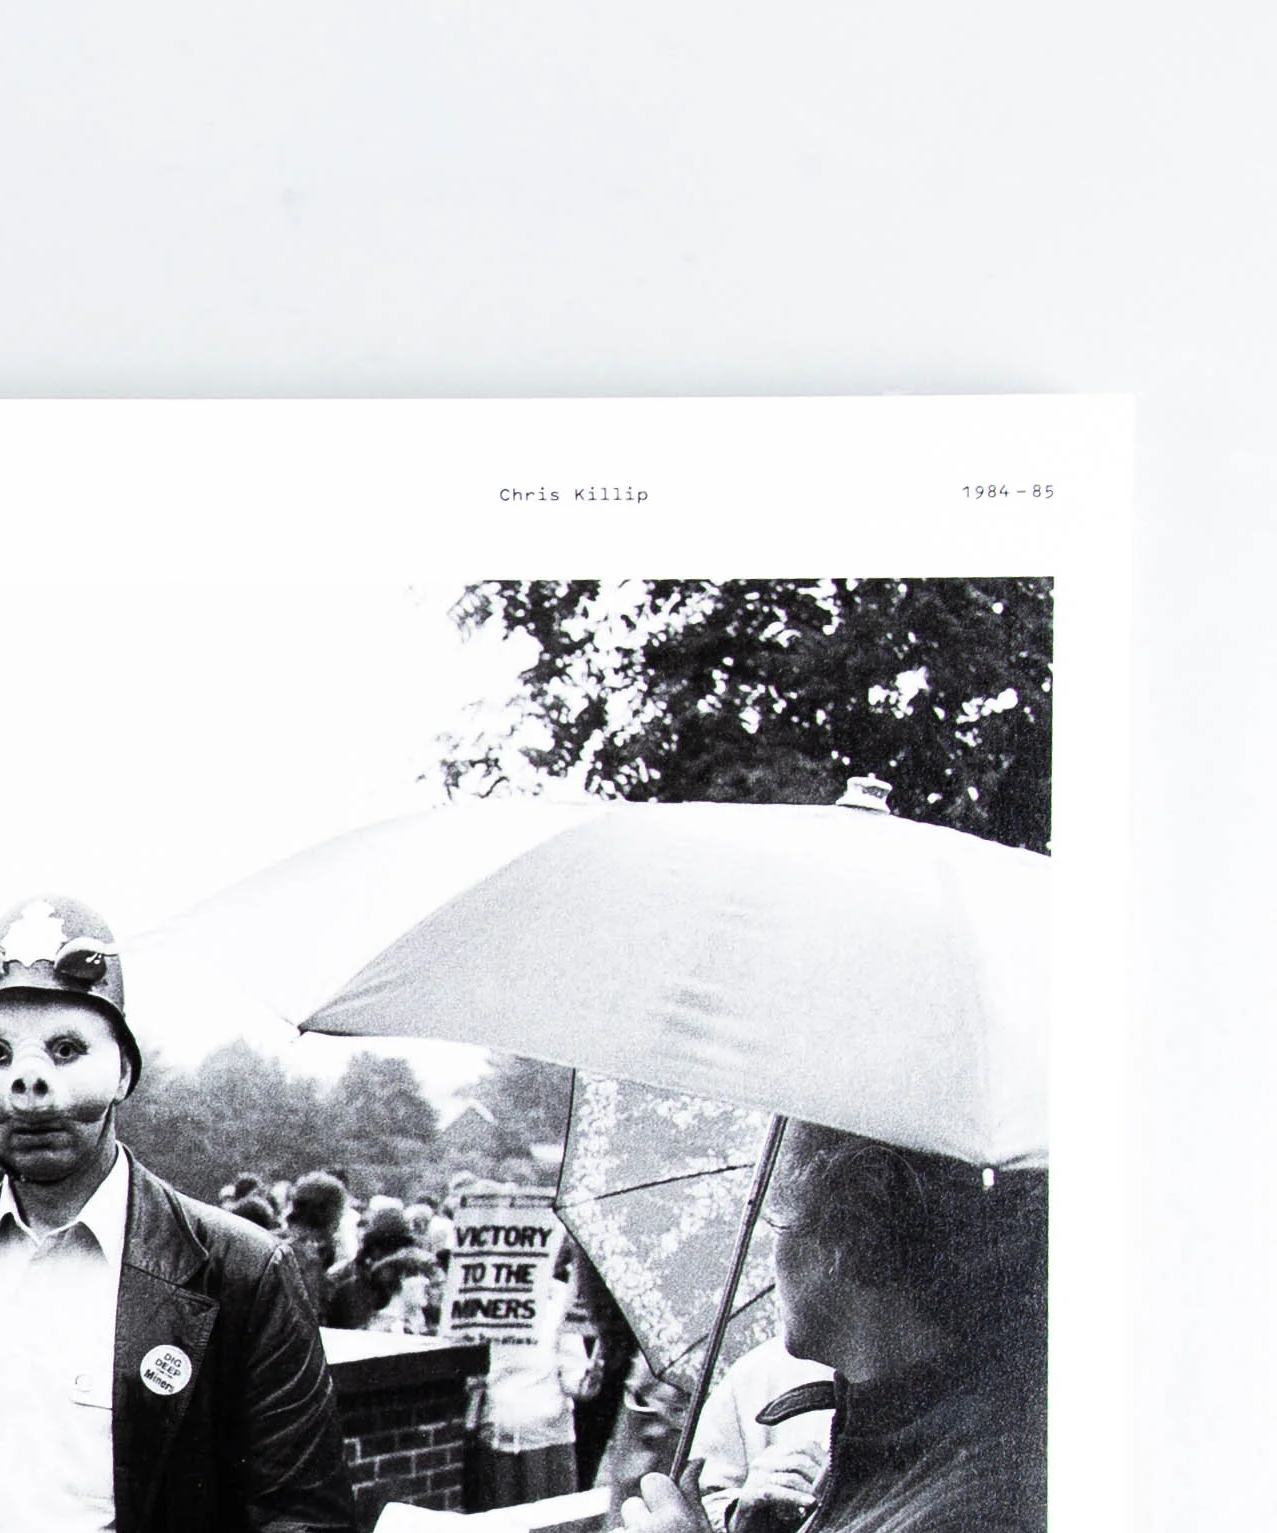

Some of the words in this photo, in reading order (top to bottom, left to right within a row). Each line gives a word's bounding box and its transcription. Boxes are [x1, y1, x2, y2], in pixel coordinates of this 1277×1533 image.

[499, 486, 560, 502] Chris
[574, 486, 649, 504] Killip
[455, 1224, 553, 1248] VICTORY
[461, 1262, 487, 1284] TO
[492, 1263, 537, 1284] THE
[451, 1298, 536, 1319] MINERS
[155, 1358, 182, 1377] DEEP
[163, 1352, 182, 1368] DIG
[143, 1368, 175, 1393] Miners
